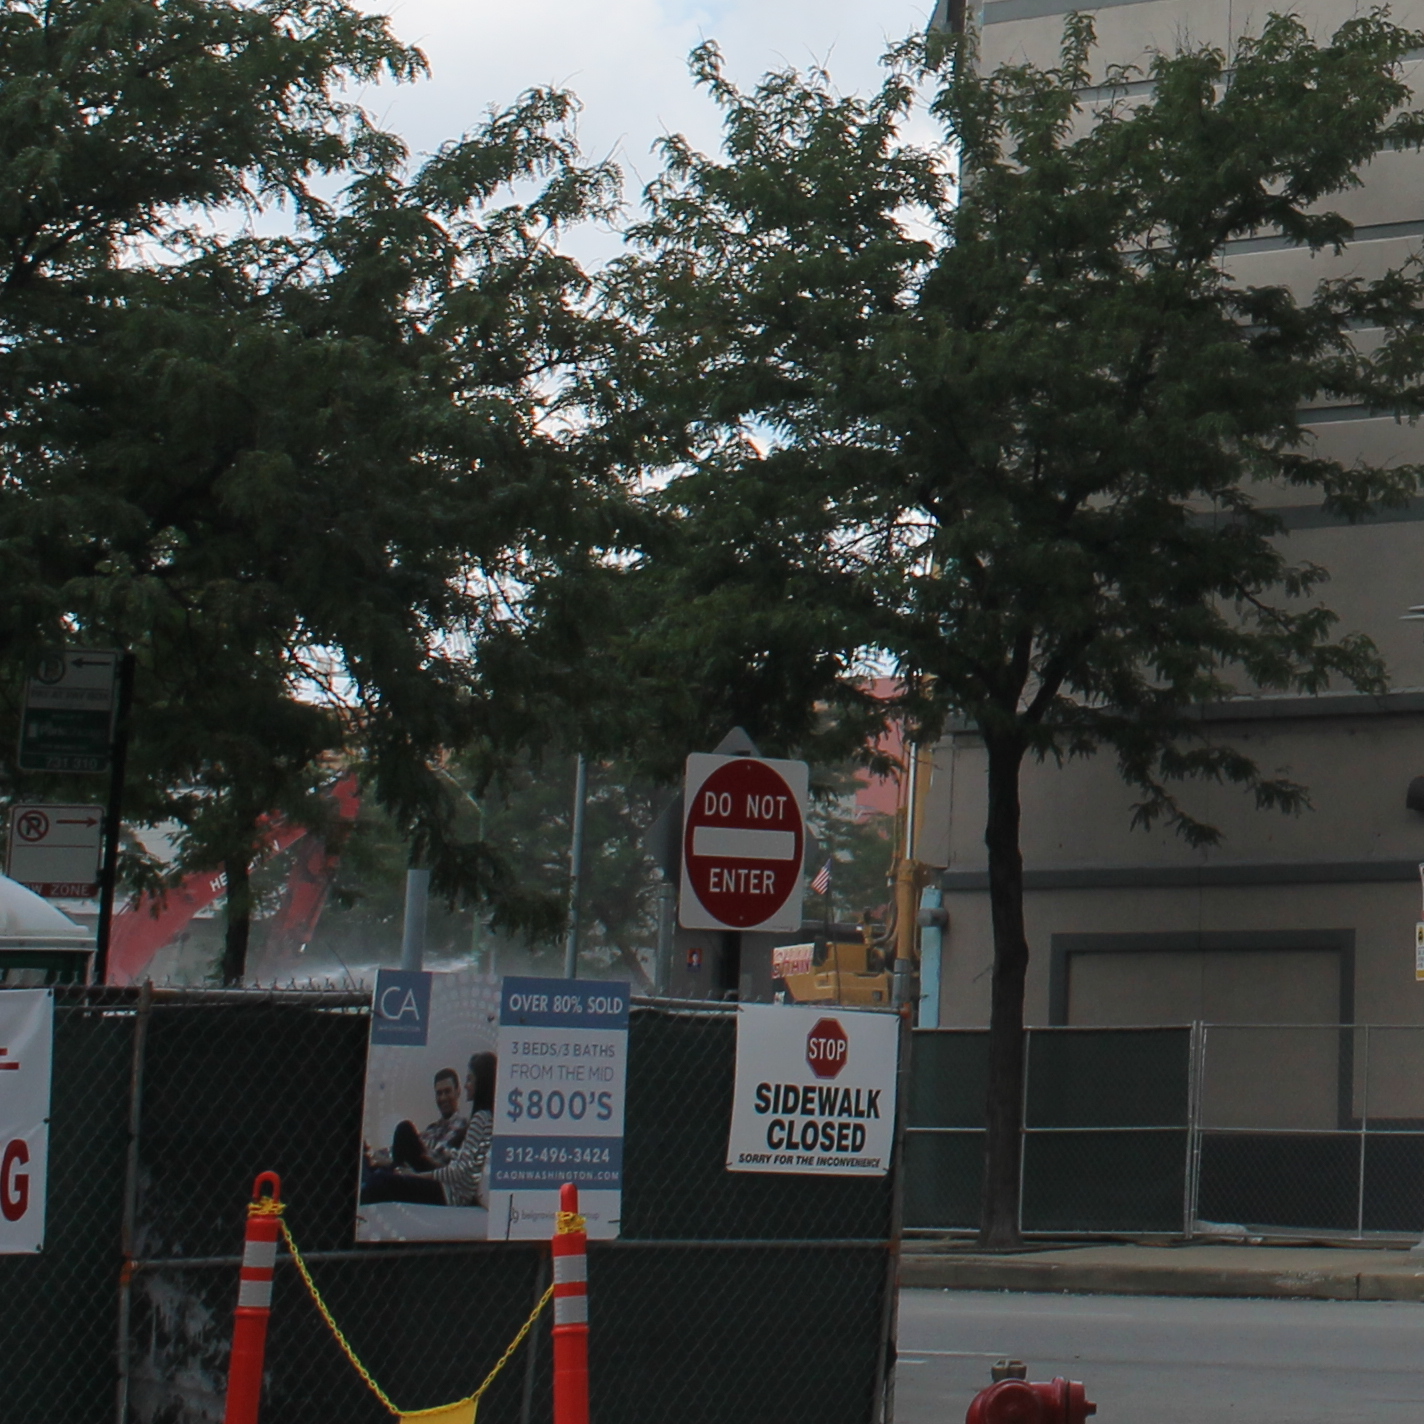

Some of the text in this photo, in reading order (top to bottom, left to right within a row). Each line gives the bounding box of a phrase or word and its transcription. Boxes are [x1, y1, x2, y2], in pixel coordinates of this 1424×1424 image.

[704, 791, 788, 820] DO NOT
[50, 884, 89, 896] ZONE
[709, 868, 775, 895] ENTER
[380, 985, 420, 1022] CA
[509, 993, 623, 1014] OVER 80% SOLD
[511, 1041, 616, 1058] 3 BEDS/3 BATHS
[808, 1038, 846, 1061] STOP
[510, 1063, 614, 1082] FROM THE MID
[754, 1082, 881, 1119] SIDEWALK
[766, 1119, 866, 1153] CLOSED
[505, 1146, 610, 1163] 312-496-3424
[738, 1153, 881, 1168] SORRY FOR THE INCONVENIENCE
